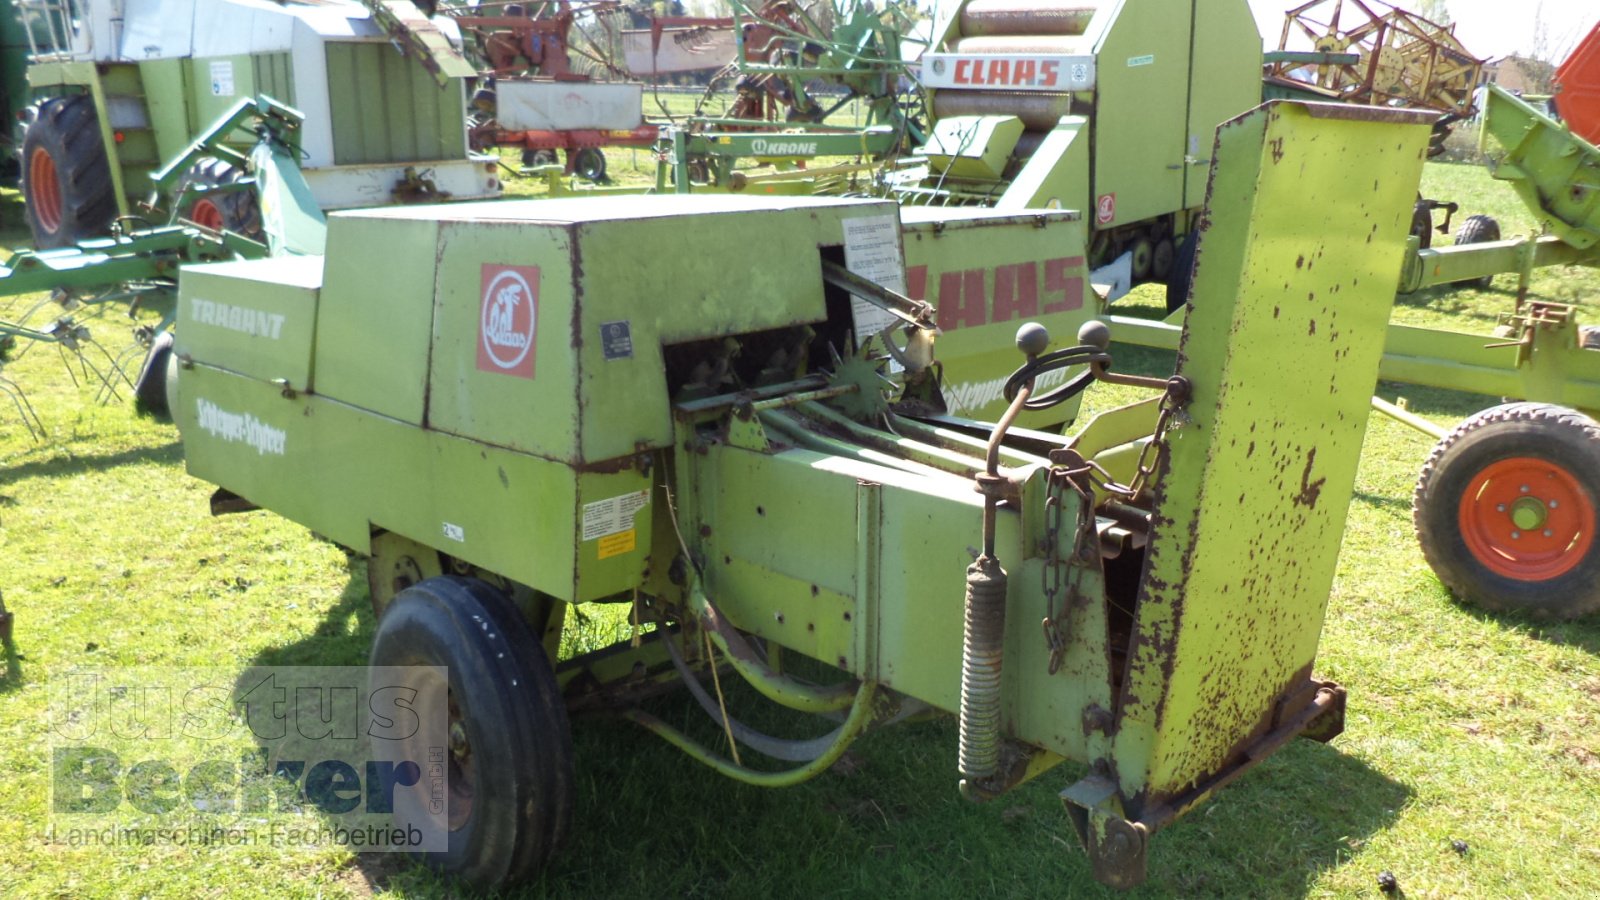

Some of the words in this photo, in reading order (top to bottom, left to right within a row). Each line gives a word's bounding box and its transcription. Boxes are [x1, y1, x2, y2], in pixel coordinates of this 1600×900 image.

[953, 59, 1060, 87] CLAAS
[768, 142, 818, 155] KRONE
[191, 298, 286, 340] TRABANT
